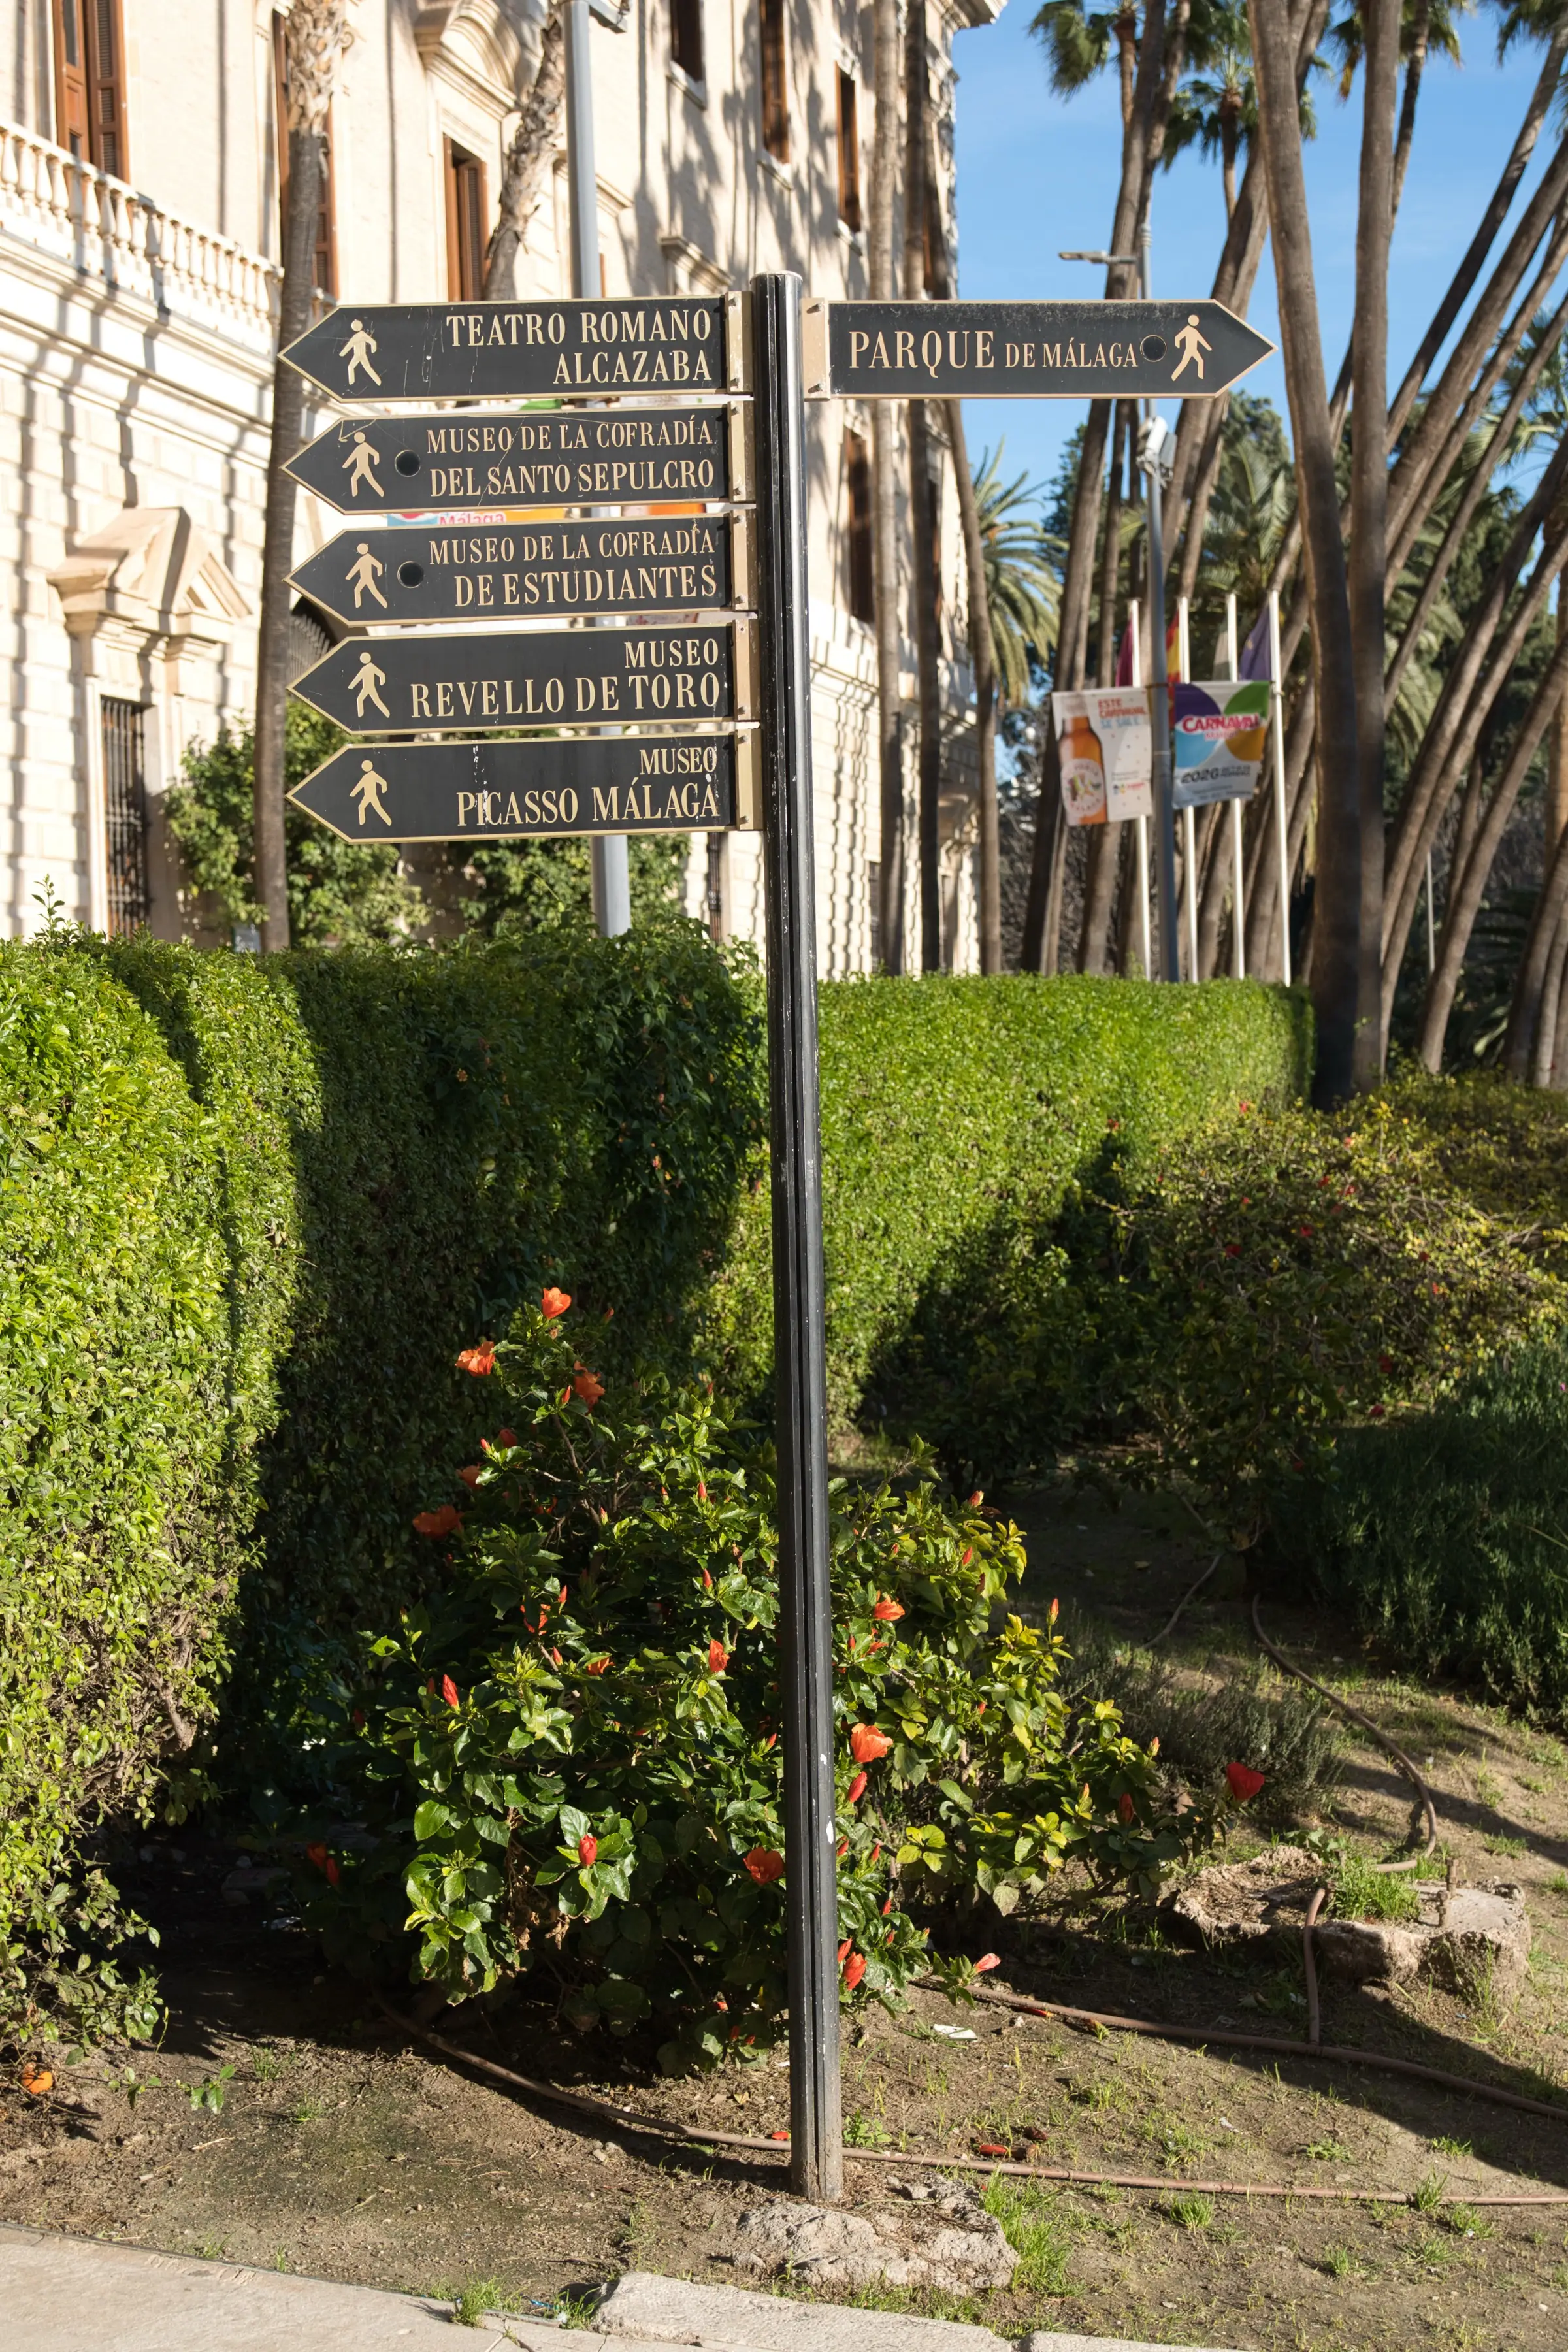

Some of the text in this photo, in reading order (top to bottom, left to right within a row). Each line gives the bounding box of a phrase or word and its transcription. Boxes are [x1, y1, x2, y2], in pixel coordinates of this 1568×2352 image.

[446, 308, 711, 347] TEATRO ROMANO
[552, 350, 712, 384] ALCAZABA
[849, 330, 1138, 378] PARQUE DE MÁLAGA
[426, 414, 713, 454] MUSEO DE LA COFRADÍA
[429, 459, 714, 497] DEL SANTO SEPULCRO
[440, 513, 504, 525] Málaga
[429, 528, 715, 565] MUSEO DE LA COFRADÍA
[454, 564, 717, 607] DE ESTUDIANTES
[624, 638, 719, 668] MUSEO
[410, 672, 719, 718] REVELLO DE TORO
[1181, 713, 1260, 733] CARNAVAL
[639, 746, 717, 775] MUSEO
[1181, 767, 1220, 783] 2026
[456, 776, 721, 826] PICASSO MÁLAGA
